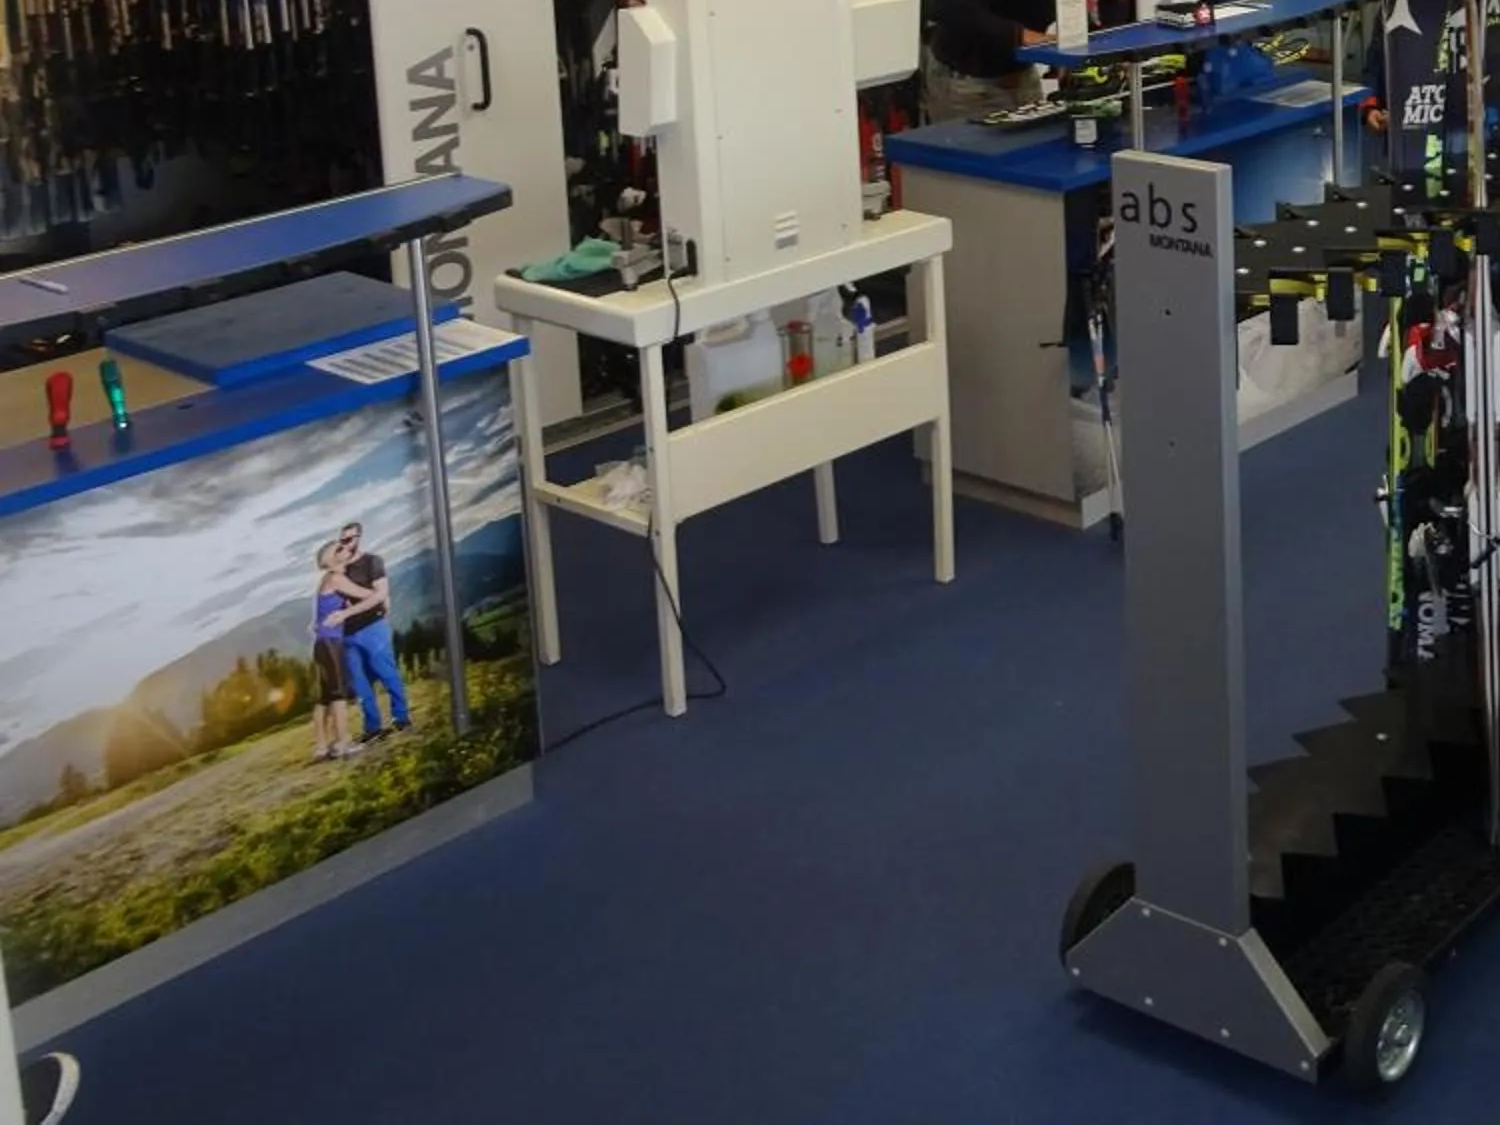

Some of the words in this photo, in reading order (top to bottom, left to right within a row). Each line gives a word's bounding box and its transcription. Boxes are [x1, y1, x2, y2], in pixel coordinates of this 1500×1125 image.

[1403, 105, 1445, 124] MIC
[1119, 181, 1198, 233] abs
[1149, 233, 1214, 259] MONTANA
